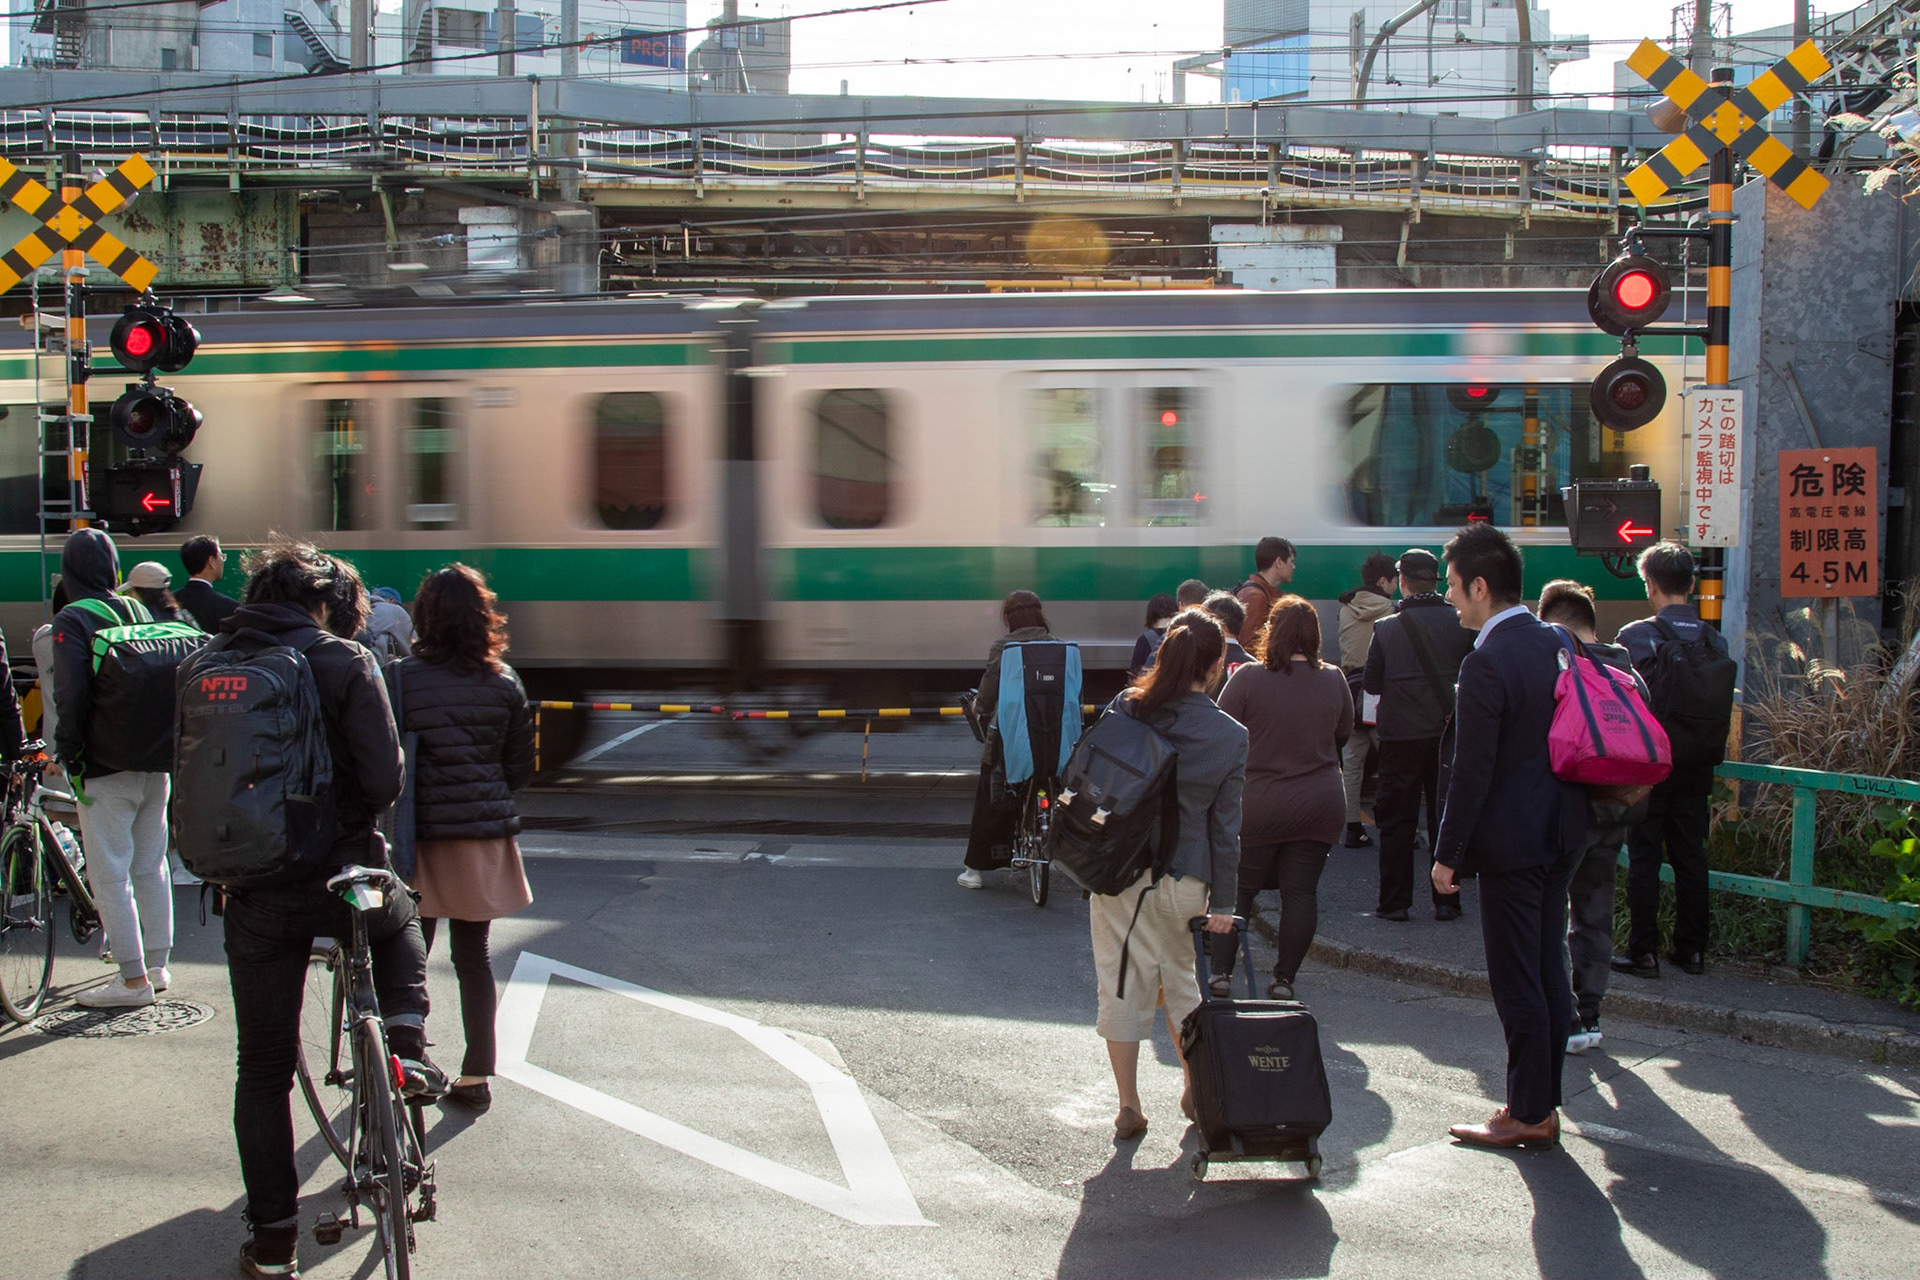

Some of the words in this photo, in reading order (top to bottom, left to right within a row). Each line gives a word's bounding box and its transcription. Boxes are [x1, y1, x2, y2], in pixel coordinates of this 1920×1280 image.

[1718, 398, 1736, 485] この踏切は
[1696, 398, 1714, 540] カメラ監視中です
[1789, 462, 1867, 497] 危険
[1789, 505, 1867, 518] 高電圧電線
[1790, 527, 1867, 552] 制限高
[1790, 561, 1868, 584] 4.5M
[1247, 1055, 1291, 1068] WENTE
